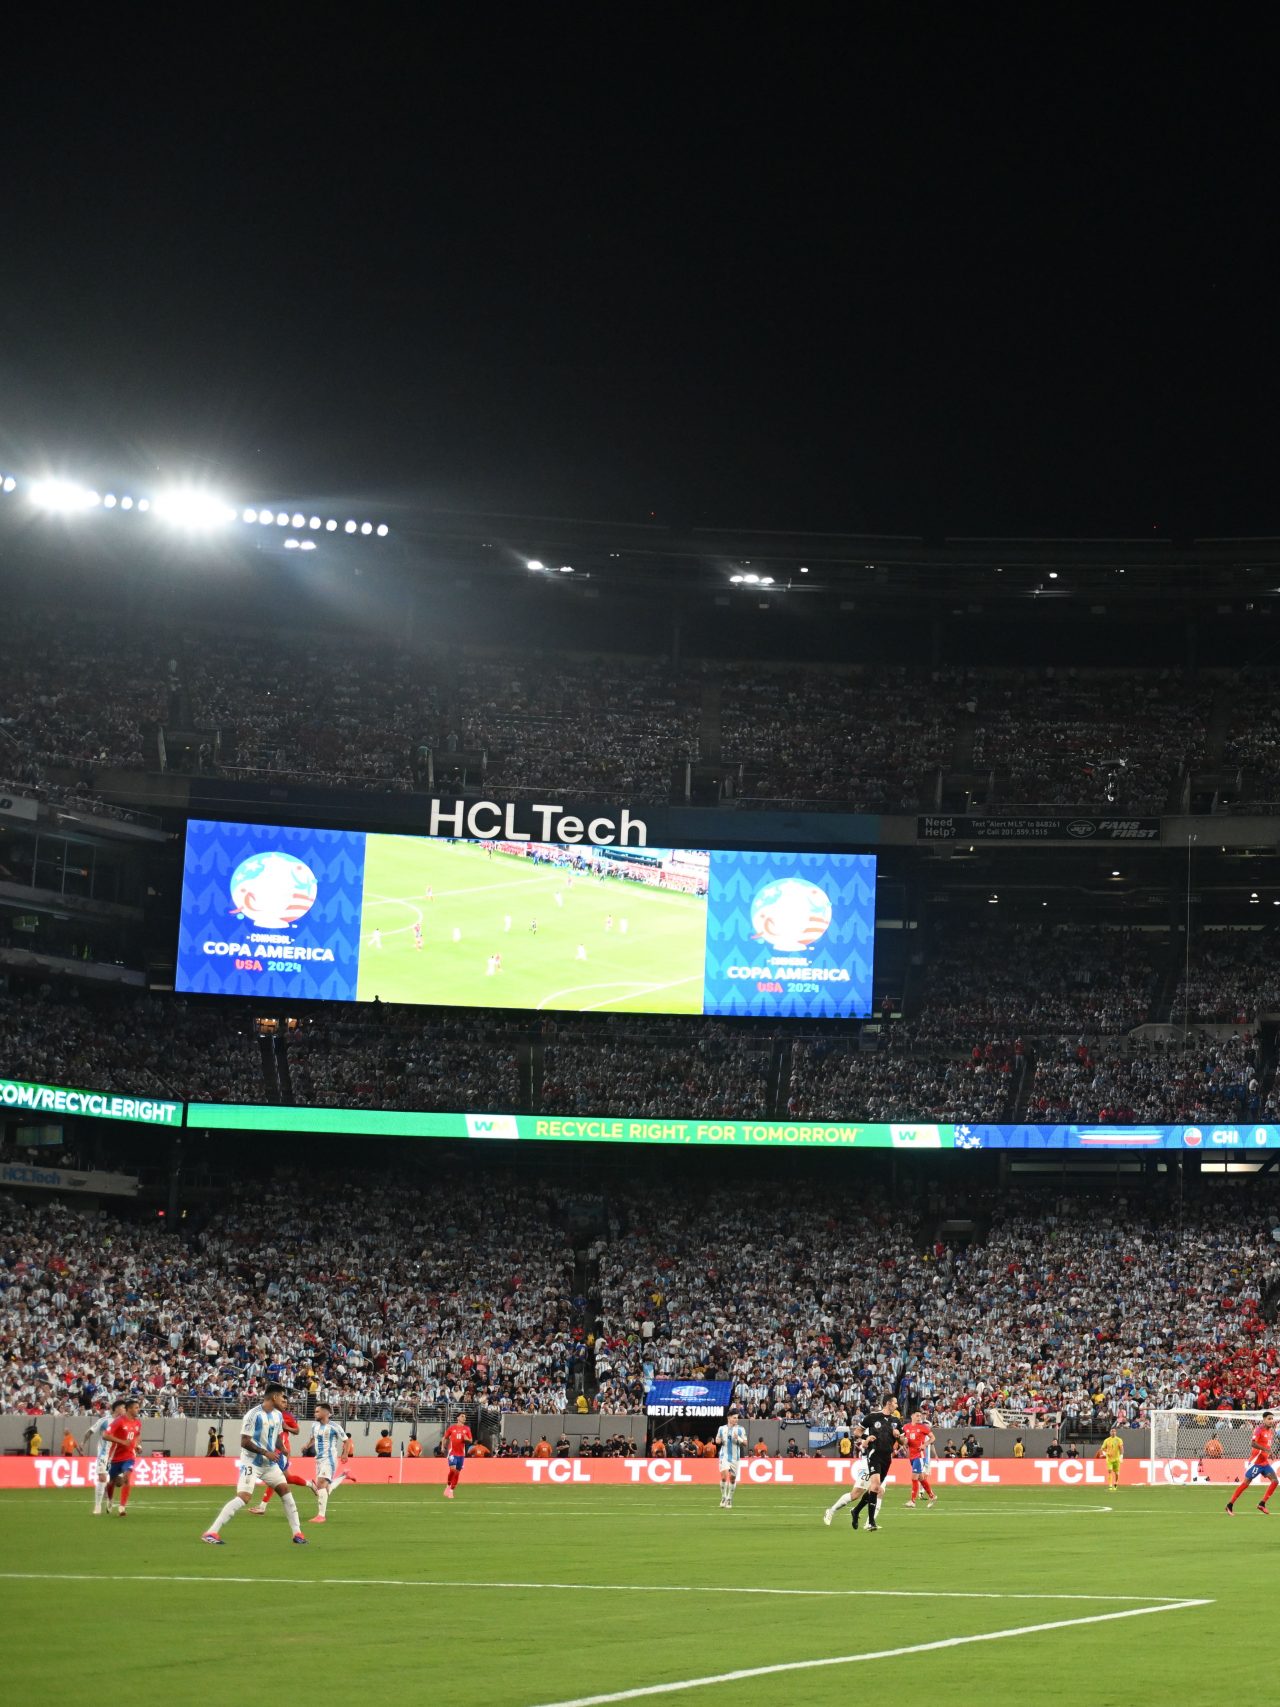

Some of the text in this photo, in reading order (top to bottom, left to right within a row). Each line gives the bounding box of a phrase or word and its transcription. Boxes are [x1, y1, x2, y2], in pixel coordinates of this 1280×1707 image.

[429, 799, 648, 847] HCLTech
[925, 818, 953, 827] Need
[1099, 821, 1141, 829] FANS
[925, 827, 956, 838] Help?
[1111, 829, 1158, 838] FIRST
[203, 941, 335, 962] COPA AMERICA
[235, 959, 302, 973] USA 2024
[726, 966, 850, 982] COPA AMERICA
[757, 982, 820, 993] USA 2024
[536, 1121, 623, 1138] RECYCLE
[629, 1124, 690, 1142] RIGHT,
[697, 1125, 736, 1141] FOR
[1212, 1128, 1266, 1145] CHI 0
[647, 1405, 724, 1417] METLIFE STADIUM
[35, 1460, 85, 1486] TCL
[526, 1460, 590, 1482] TCL
[624, 1460, 692, 1482] TCL
[1034, 1460, 1105, 1483] TCL
[1139, 1460, 1208, 1483] TCL
